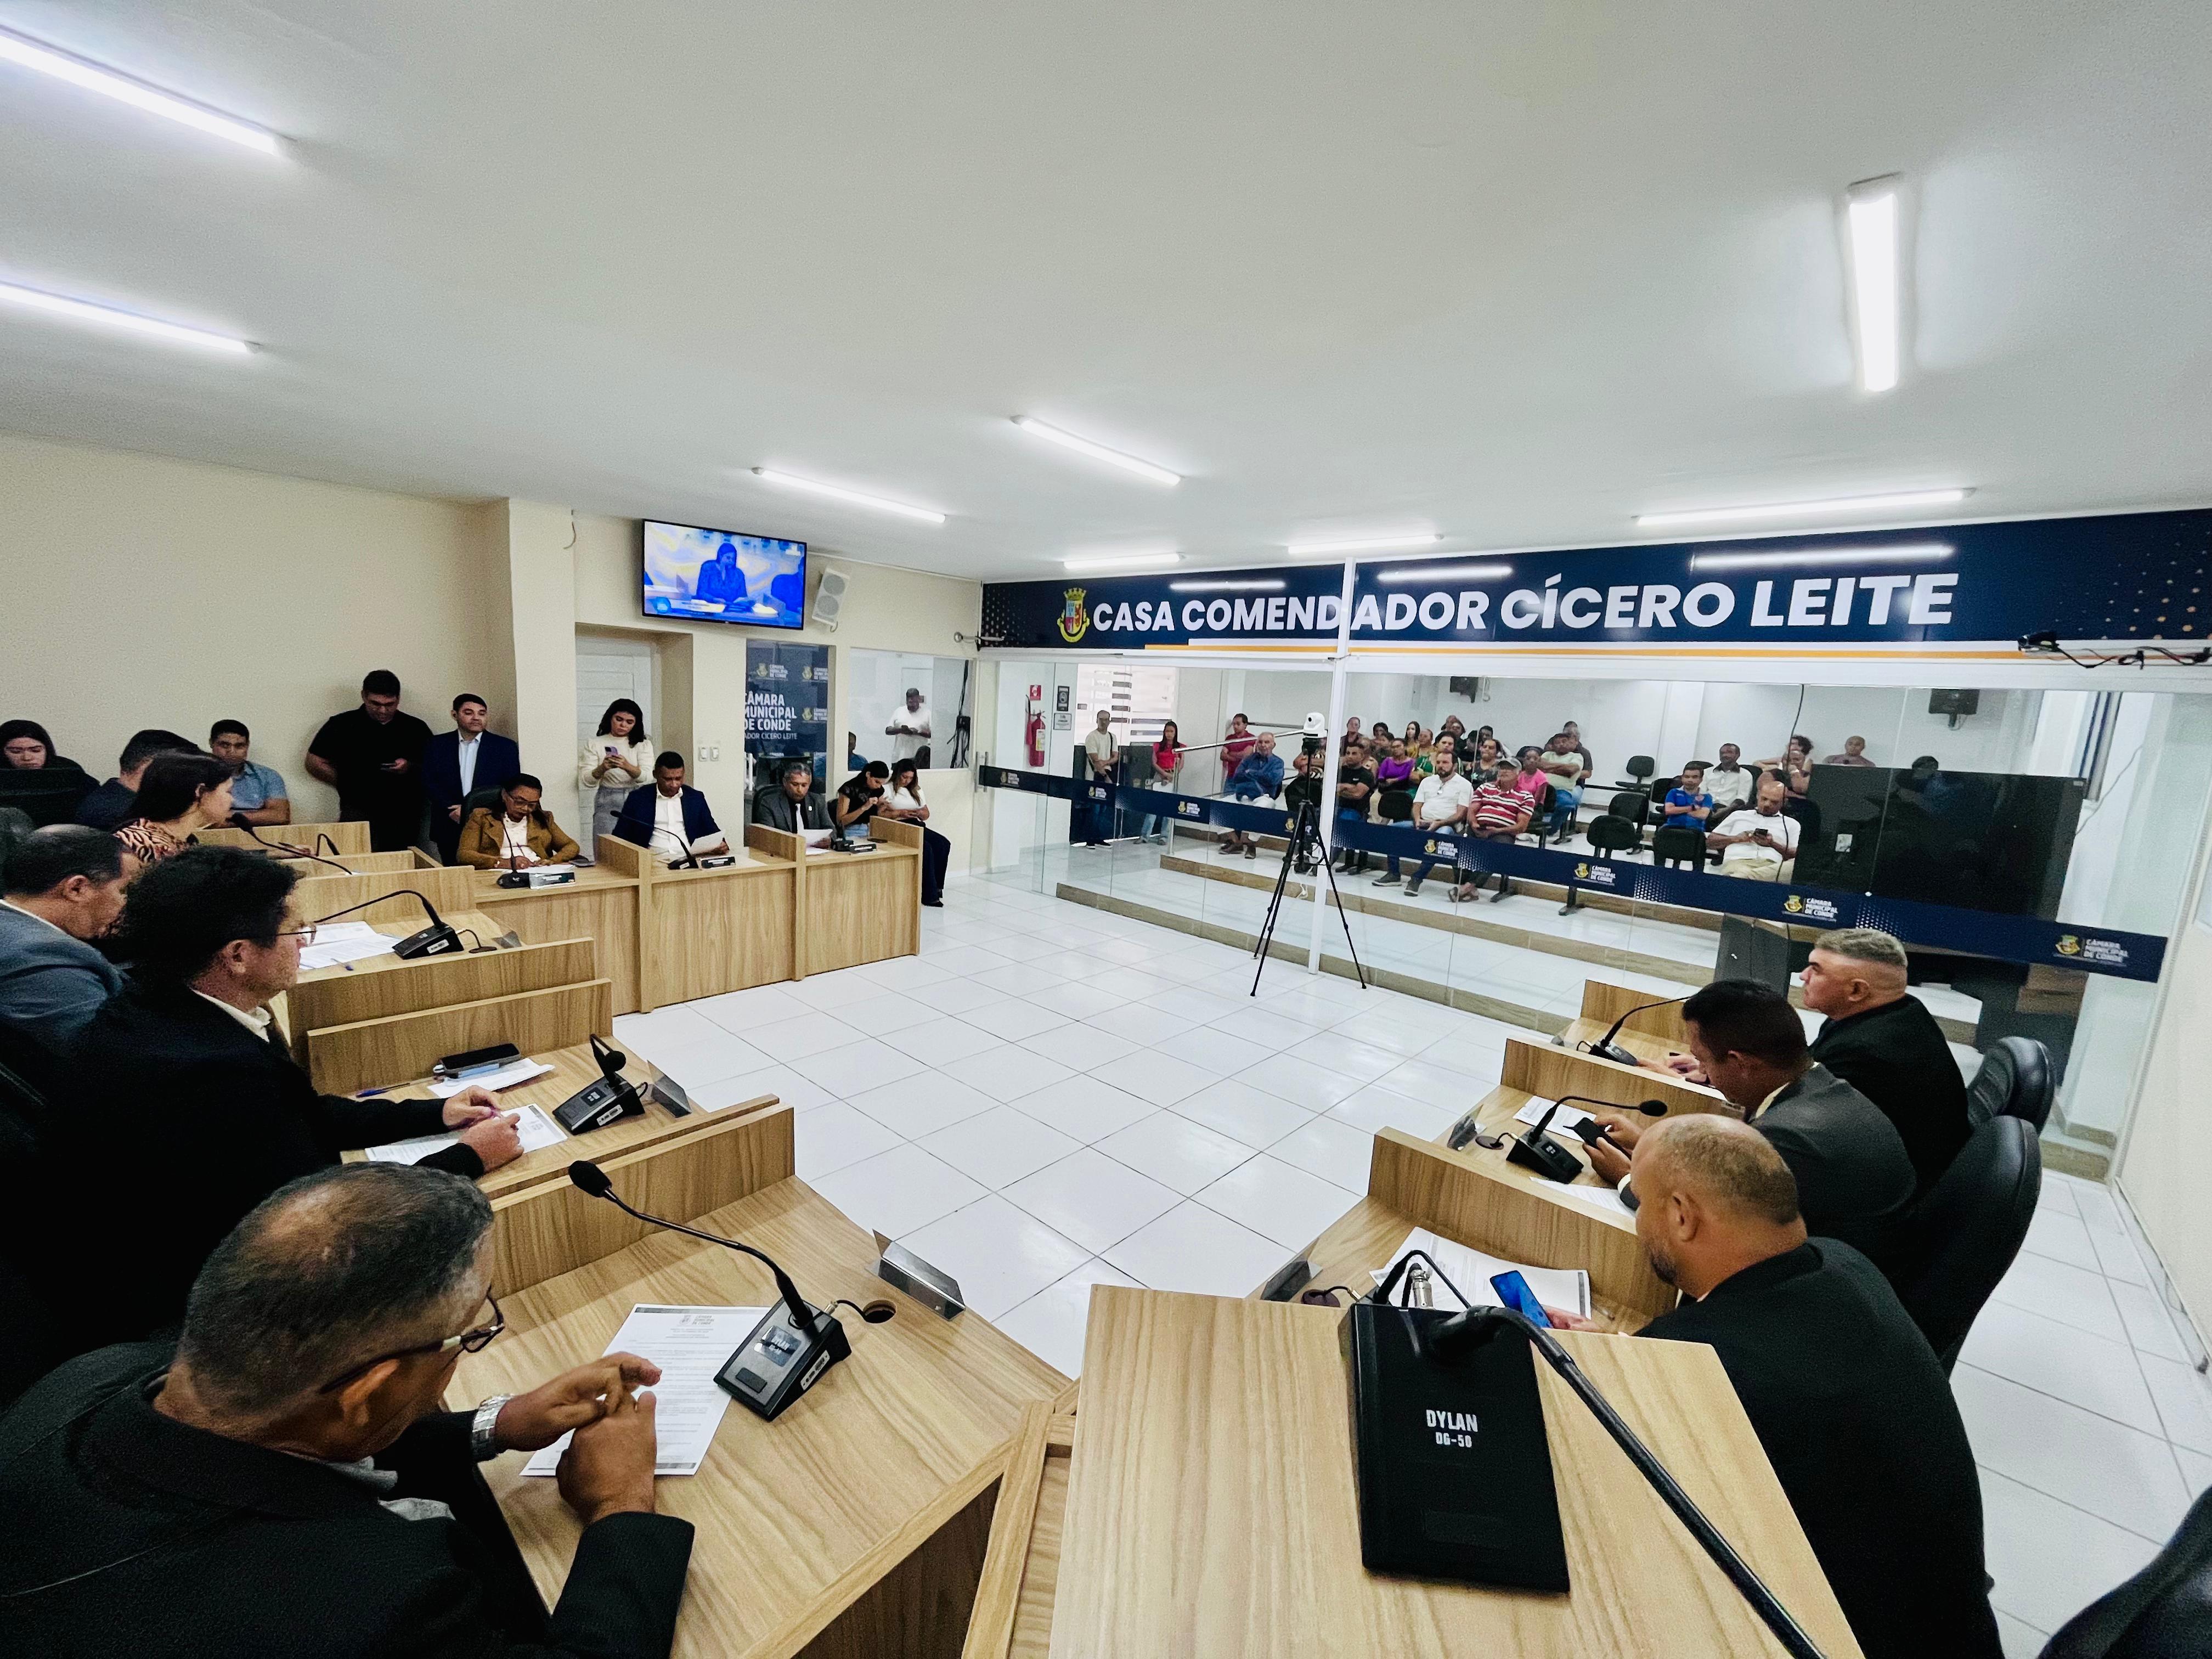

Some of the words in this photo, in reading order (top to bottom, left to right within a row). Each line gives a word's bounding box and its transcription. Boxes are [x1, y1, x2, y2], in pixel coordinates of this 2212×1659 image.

[1093, 601, 1175, 631] CASA
[1182, 591, 1489, 631] COMENDADOR
[1501, 573, 1735, 629] CÍCERO
[1751, 573, 1959, 627] LEITE
[757, 719, 791, 731] CONDE
[1426, 1409, 1479, 1432] DYLAN
[1435, 1431, 1472, 1448] DG-50
